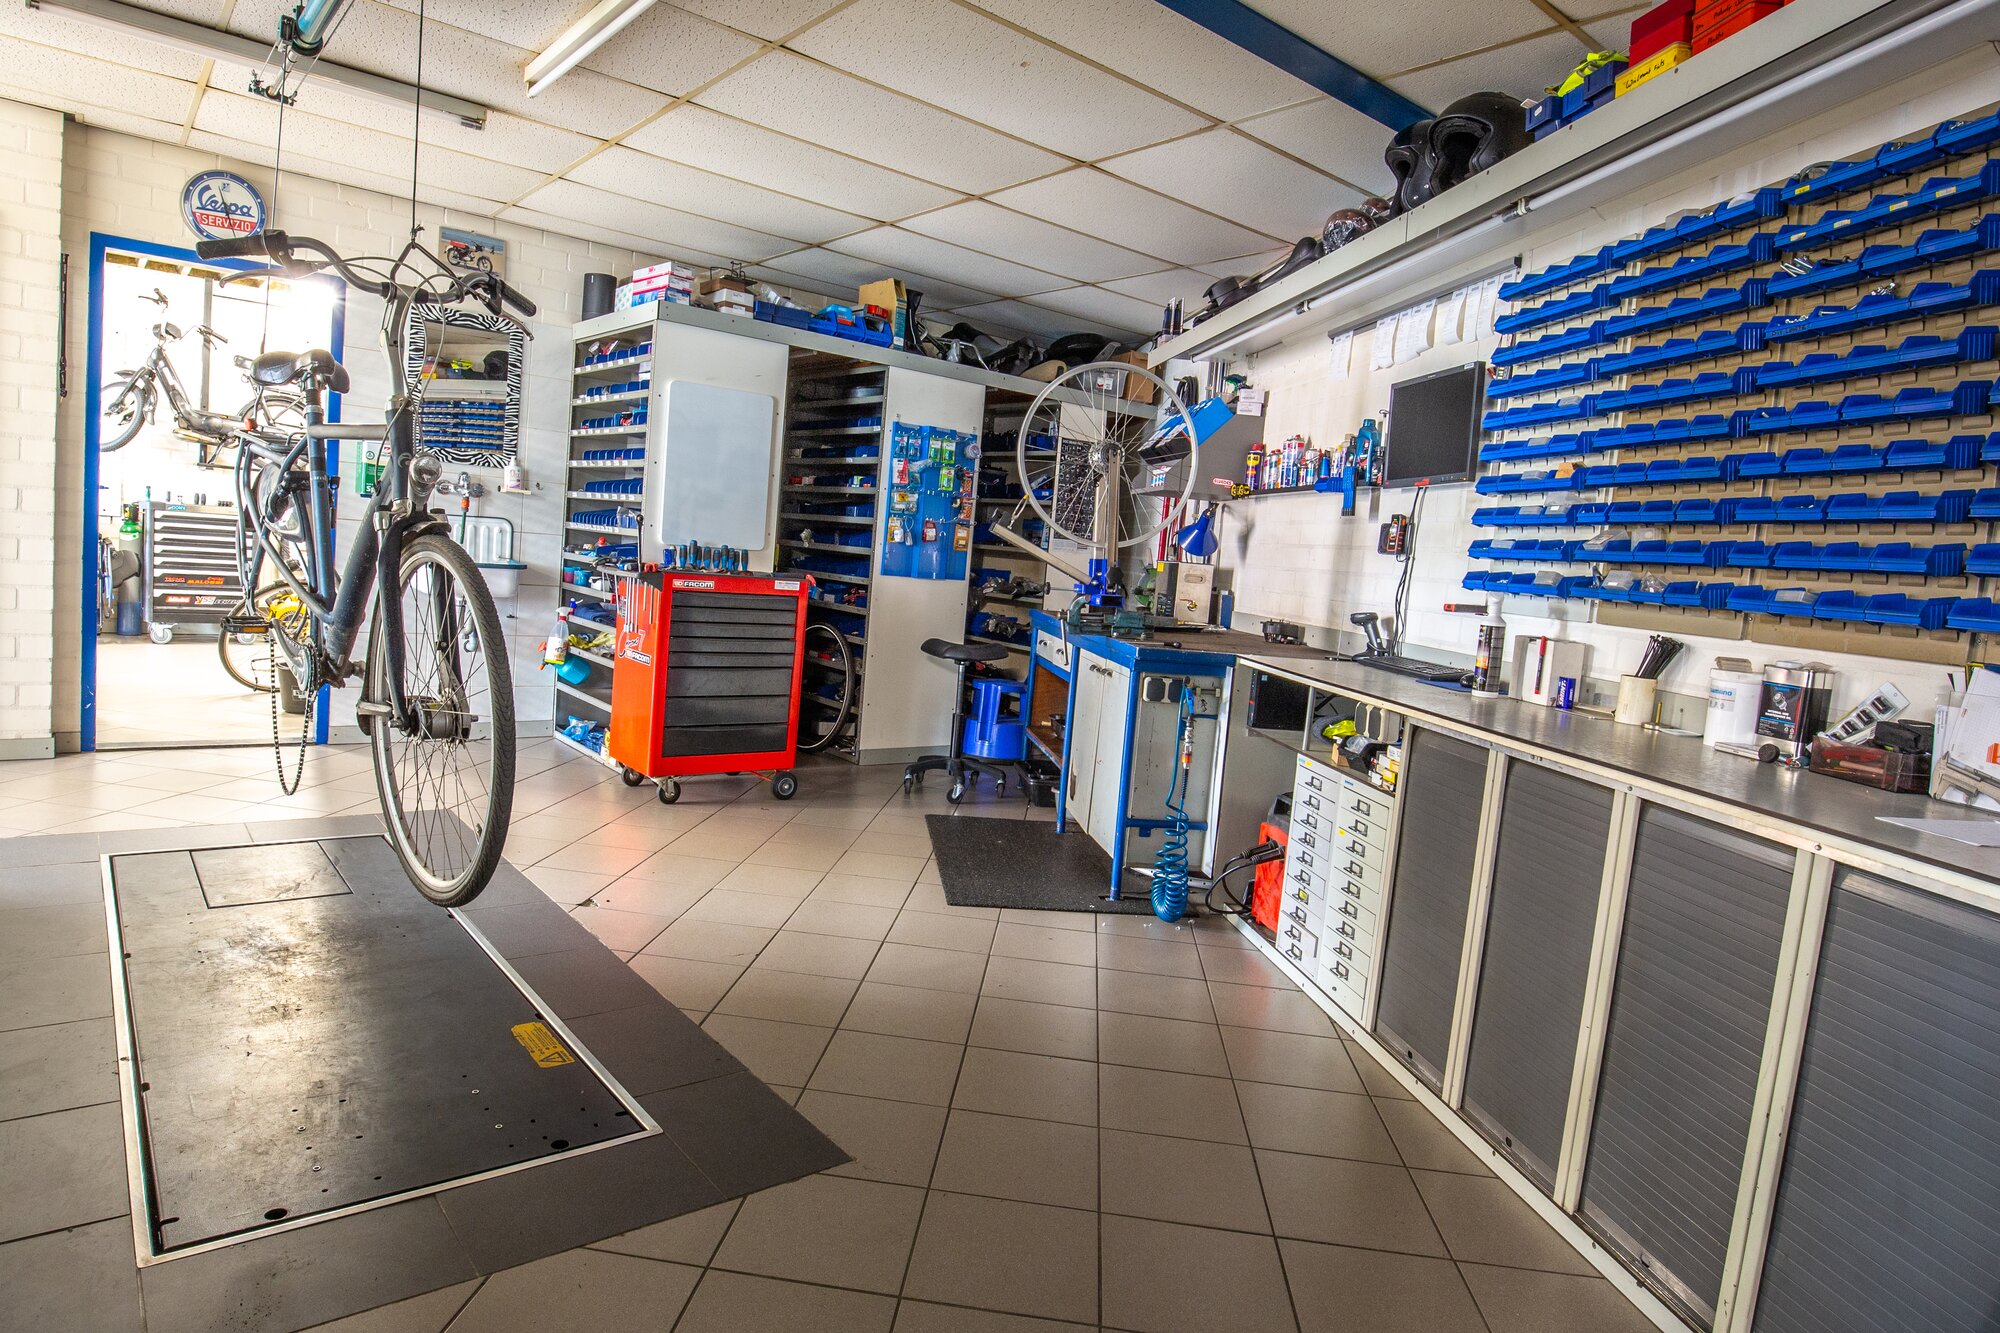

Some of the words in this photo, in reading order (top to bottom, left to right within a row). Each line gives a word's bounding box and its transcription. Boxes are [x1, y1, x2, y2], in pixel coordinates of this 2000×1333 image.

[196, 184, 255, 218] Vespa
[201, 215, 251, 232] SERVIZIO
[631, 650, 651, 664] FACOM
